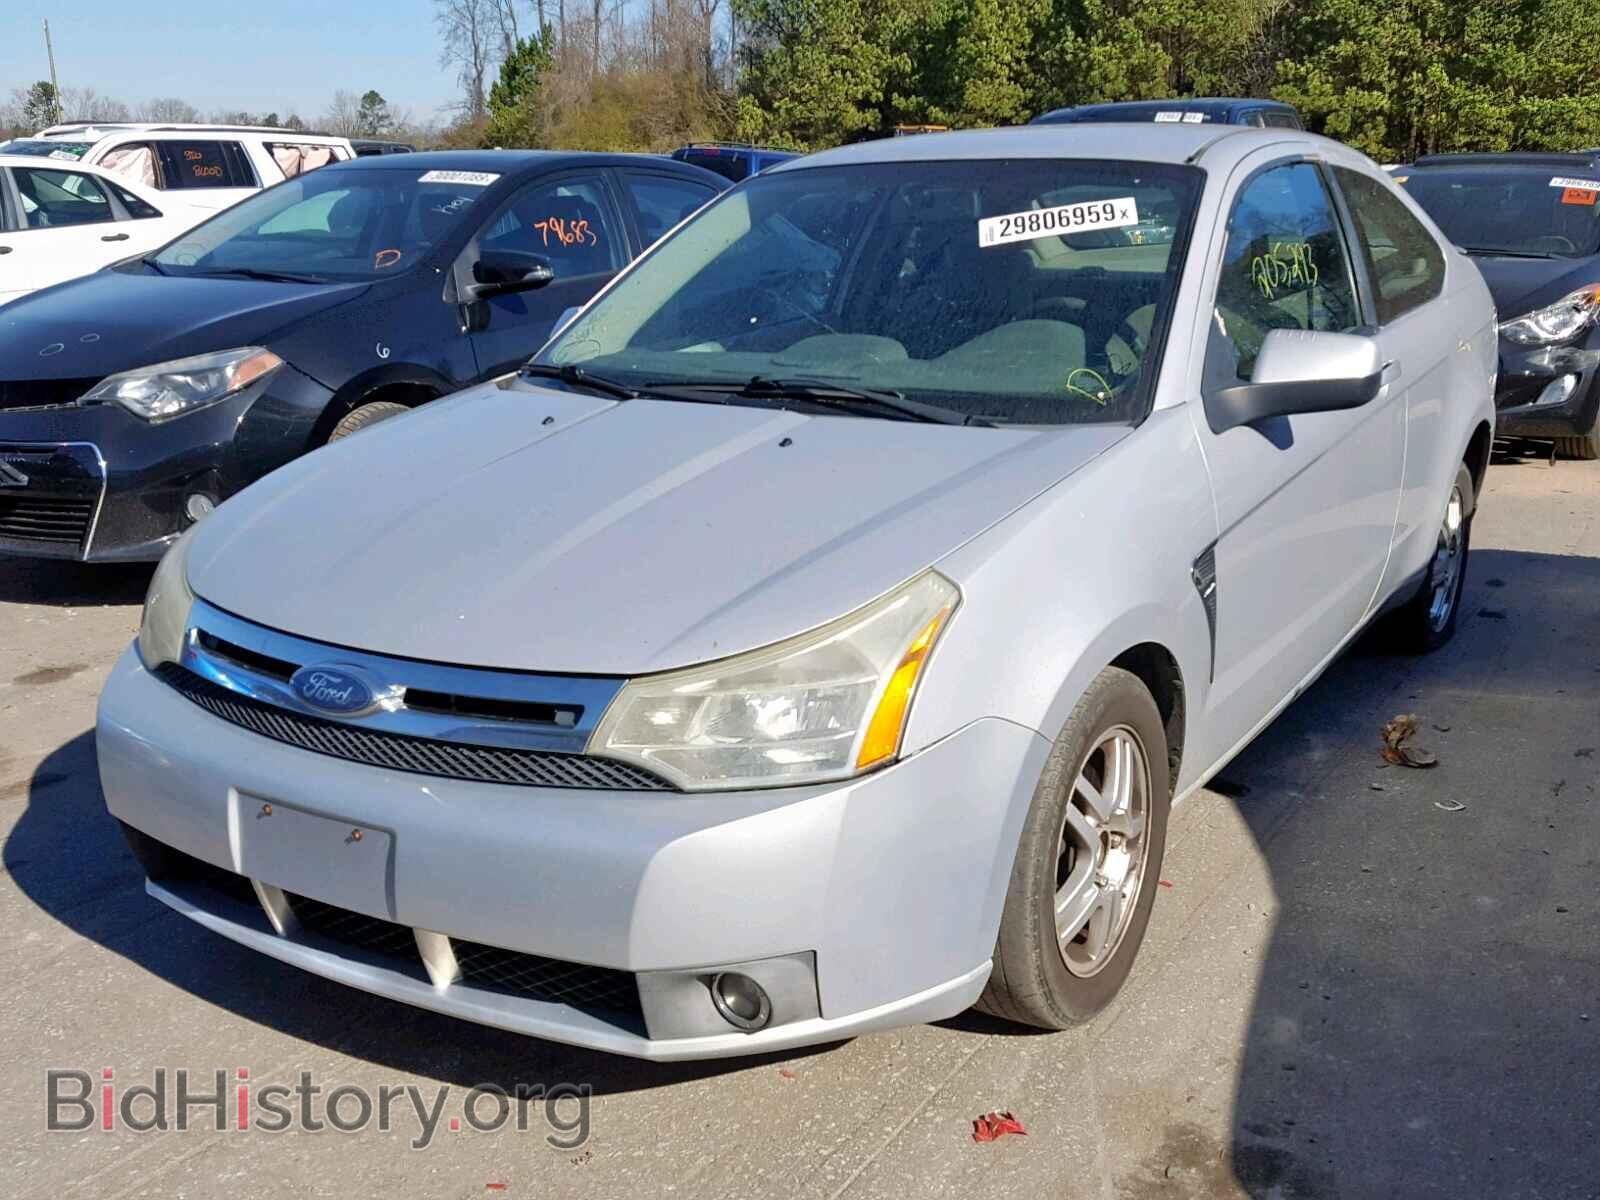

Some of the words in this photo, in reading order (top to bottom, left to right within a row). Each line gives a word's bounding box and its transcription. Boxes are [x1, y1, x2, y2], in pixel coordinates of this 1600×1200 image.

[533, 217, 597, 247] 79683
[375, 342, 391, 359] 6
[303, 672, 354, 705] Ford
